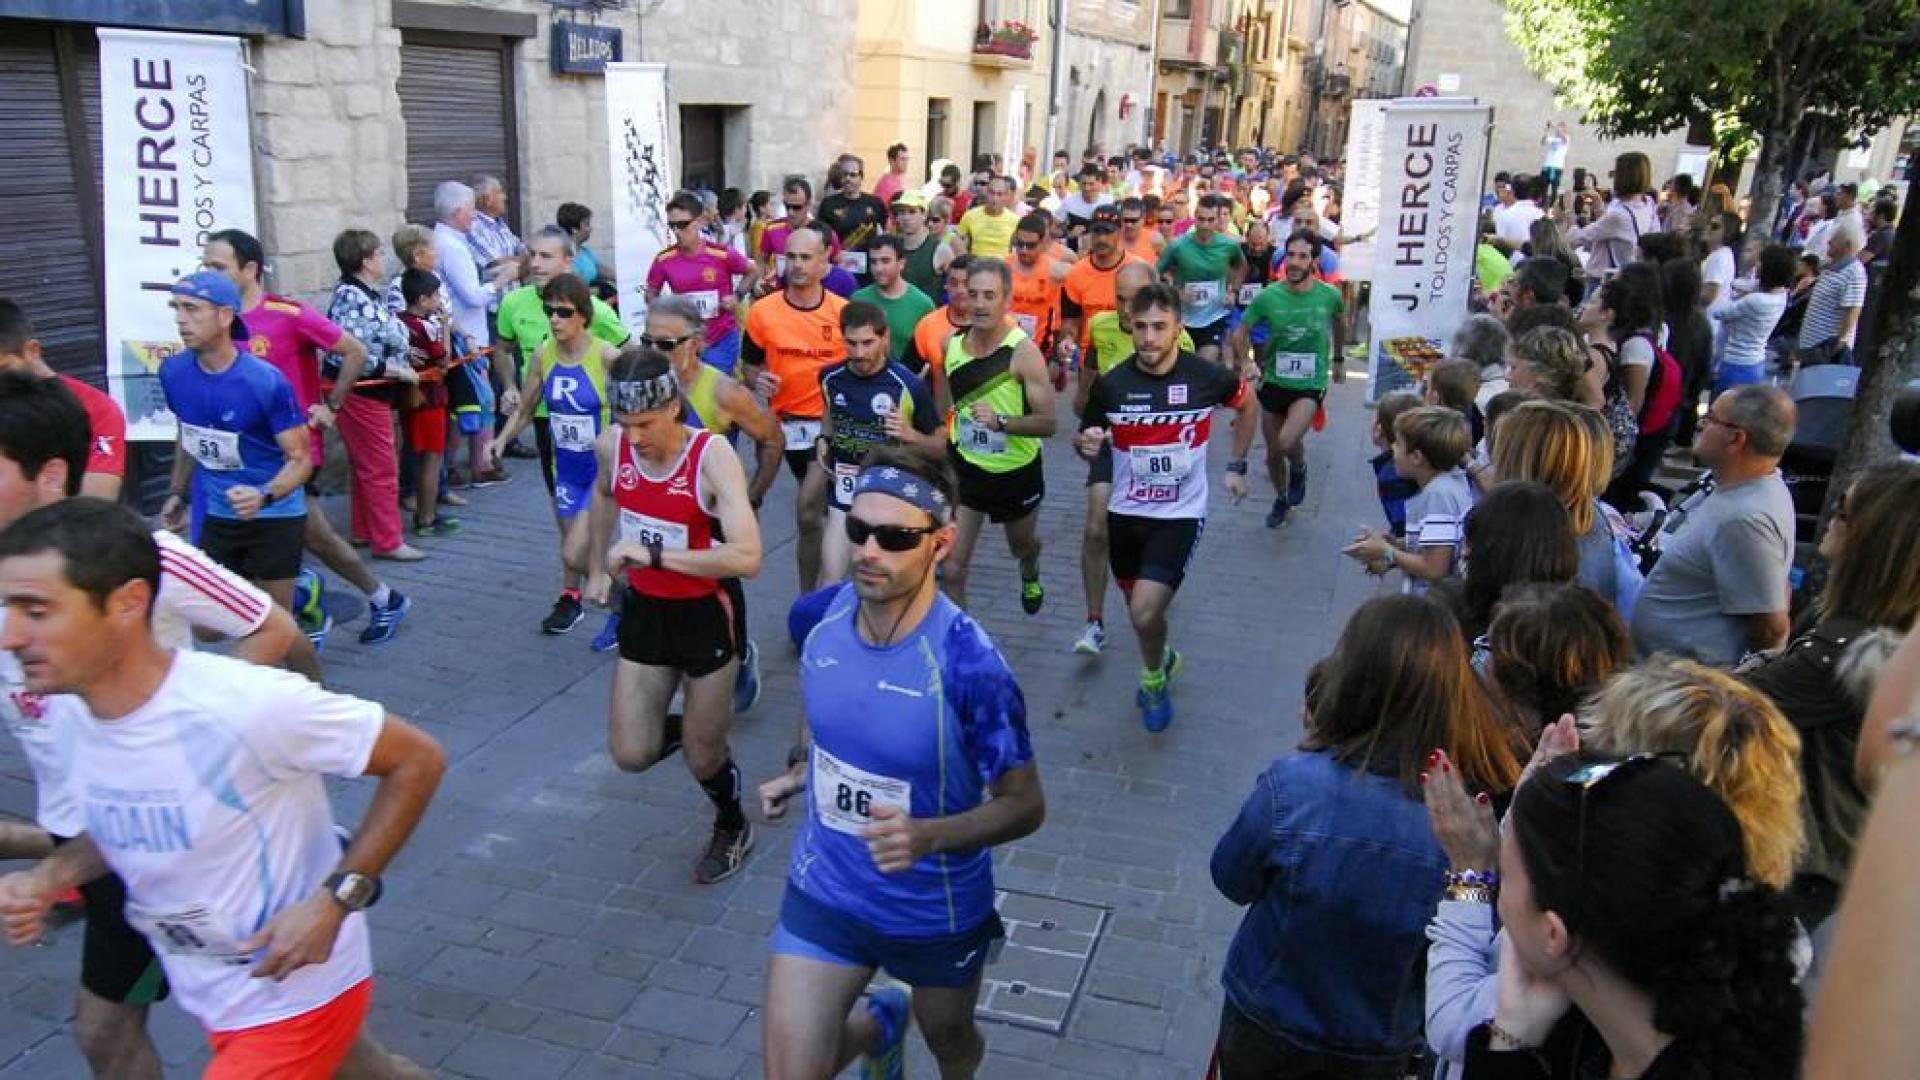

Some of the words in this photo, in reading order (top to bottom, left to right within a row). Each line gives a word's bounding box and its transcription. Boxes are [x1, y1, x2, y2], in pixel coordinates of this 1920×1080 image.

[186, 74, 212, 169] CARPAS
[132, 57, 181, 247] HERCE
[1442, 130, 1464, 206] CARPAS
[193, 175, 214, 190] Y
[1395, 123, 1438, 266] HERCE
[1440, 208, 1455, 223] Y
[1429, 222, 1453, 303] TOLDOS
[1391, 281, 1421, 311] J.
[551, 375, 591, 412] R
[199, 439, 220, 458] 53
[1149, 456, 1172, 474] 80
[836, 782, 873, 818] 86
